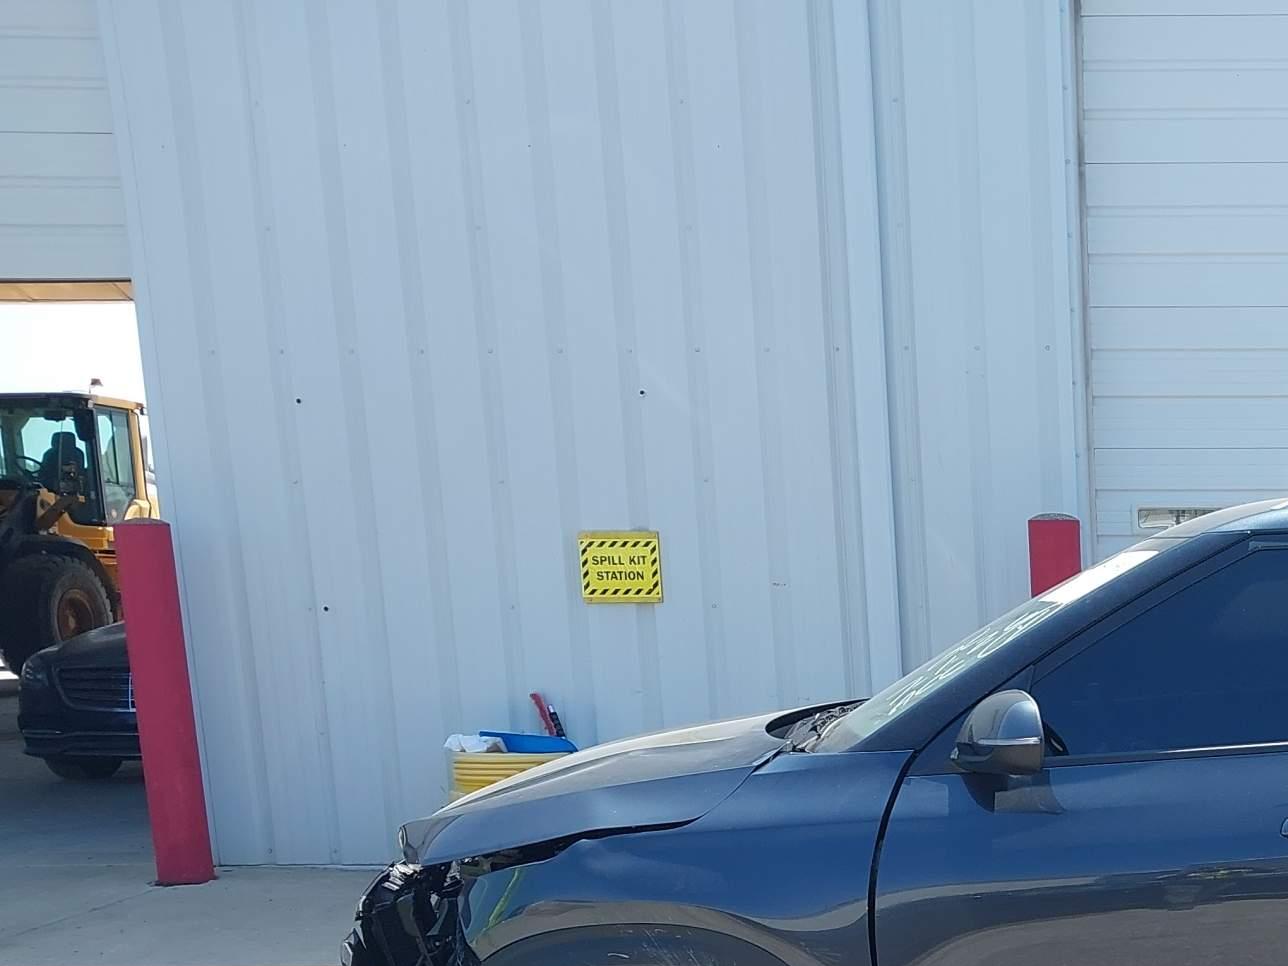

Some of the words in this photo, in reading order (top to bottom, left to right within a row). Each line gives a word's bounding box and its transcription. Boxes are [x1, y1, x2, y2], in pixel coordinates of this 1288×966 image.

[591, 555, 625, 565] SPILL
[629, 555, 647, 565] KIT
[596, 571, 644, 581] STATION
